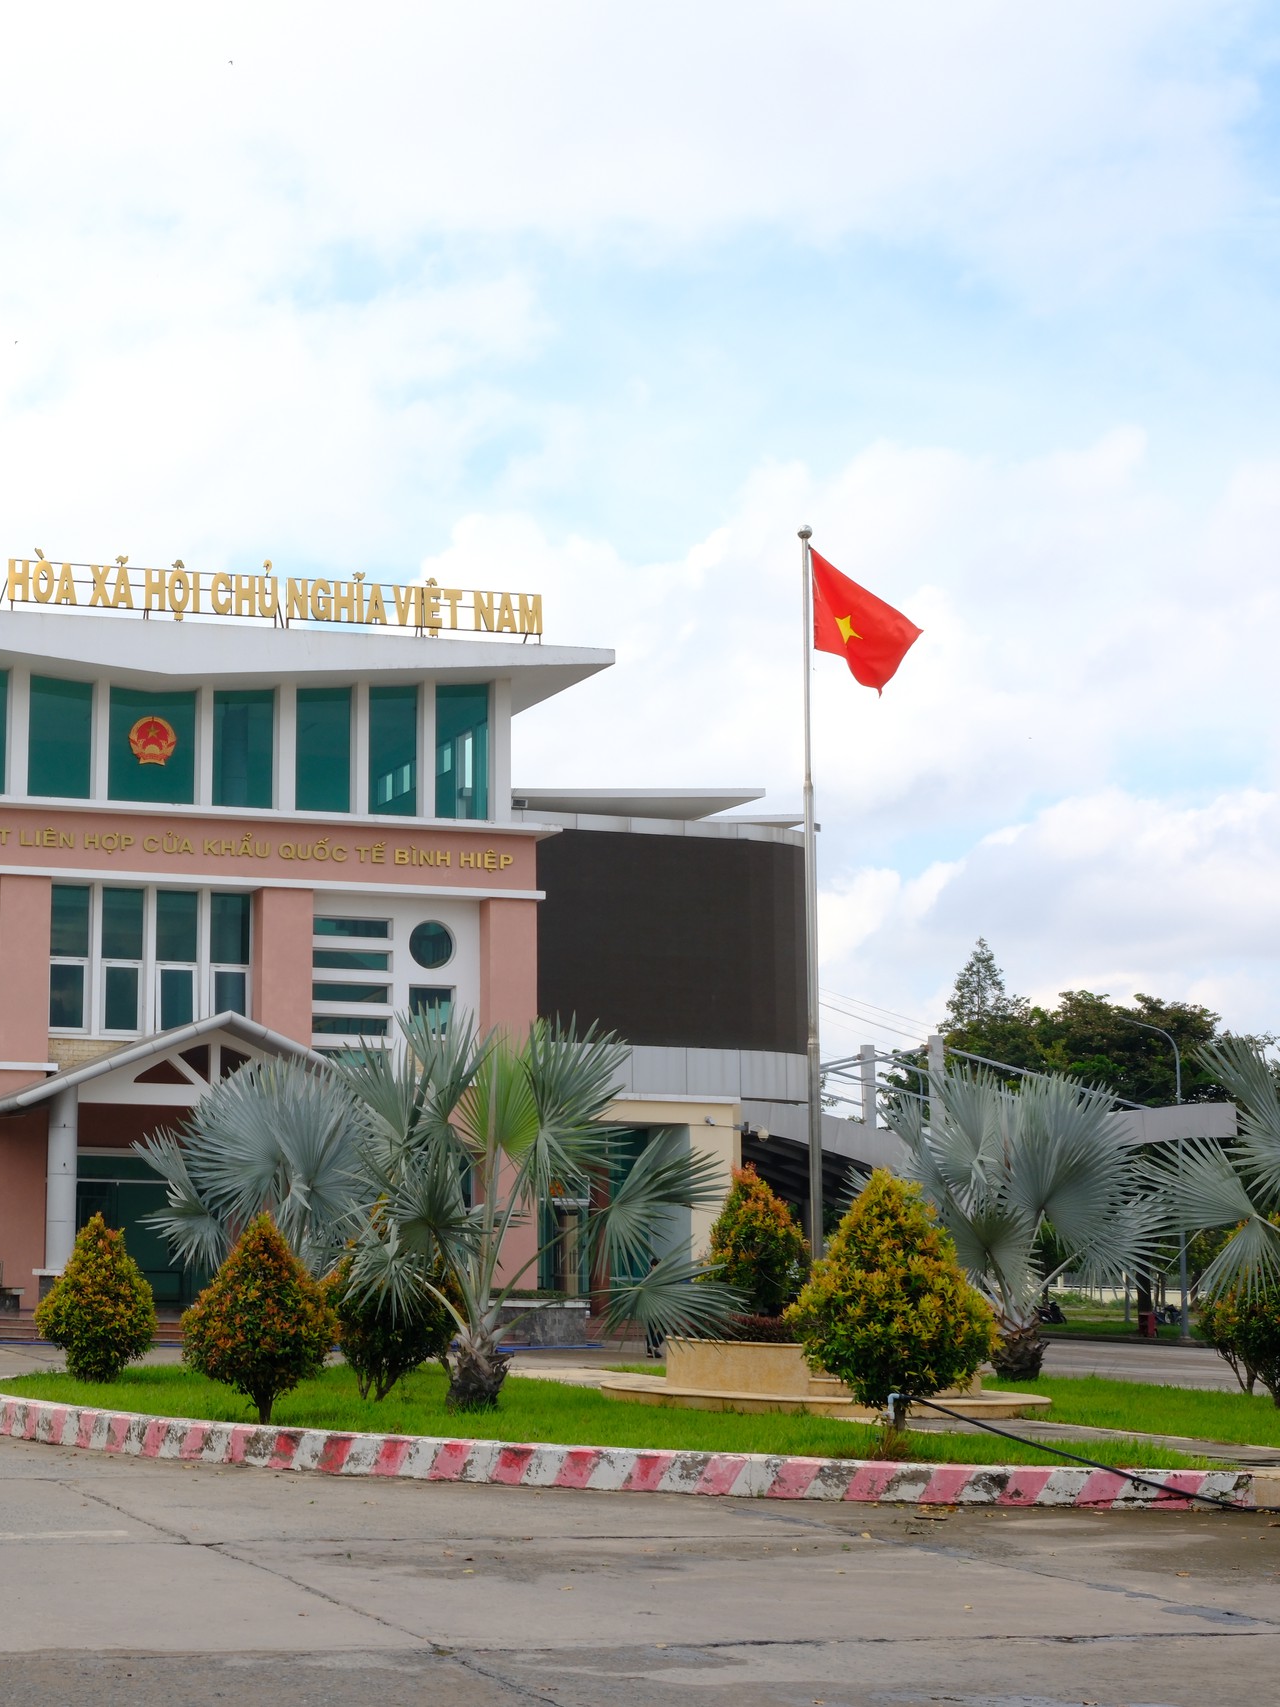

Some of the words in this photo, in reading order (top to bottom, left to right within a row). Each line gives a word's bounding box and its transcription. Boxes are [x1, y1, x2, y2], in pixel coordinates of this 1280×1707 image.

[8, 547, 77, 604] HÒA
[89, 555, 134, 609] XÃ
[144, 559, 200, 621] HỘI
[211, 559, 278, 618] CHỦ
[287, 571, 388, 624] NGHĨA
[392, 577, 462, 638] VIỆT
[474, 590, 542, 635] NAM
[20, 827, 74, 848] LIÊN
[84, 831, 135, 855] HỢP
[143, 831, 195, 855] CỬA
[203, 832, 270, 859] KHẨU
[278, 837, 348, 863] QUỐC
[356, 840, 386, 864] TẾ
[394, 847, 451, 868] BÌNH
[460, 849, 514, 873] HIỆP
